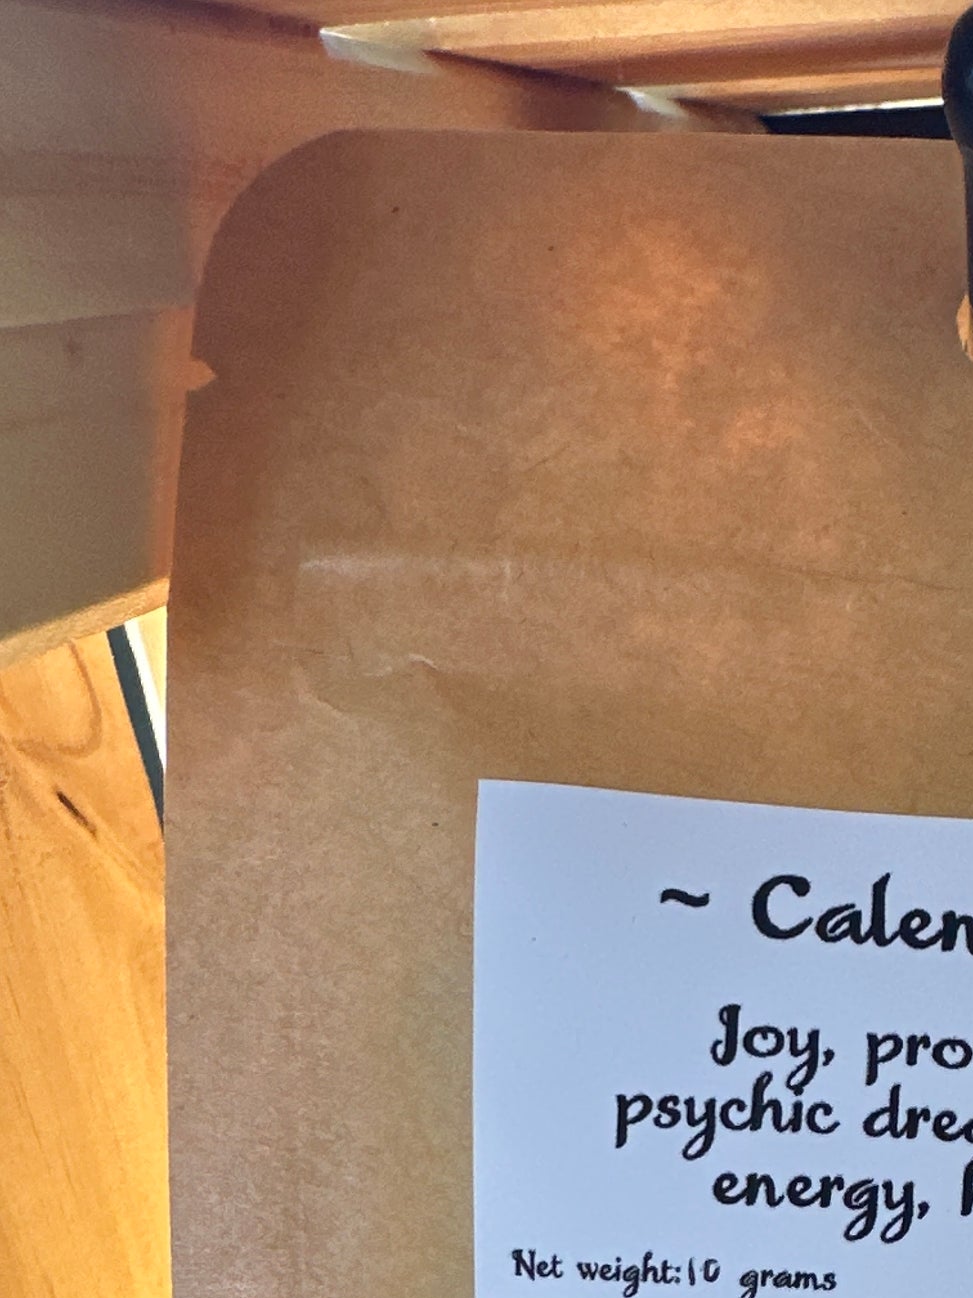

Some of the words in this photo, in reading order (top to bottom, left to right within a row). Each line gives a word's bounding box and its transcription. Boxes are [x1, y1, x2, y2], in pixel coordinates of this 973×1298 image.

[709, 1003, 836, 1097] Joy,
[614, 1070, 841, 1162] psychic
[711, 1171, 931, 1245] energy,
[511, 1248, 564, 1282] Net
